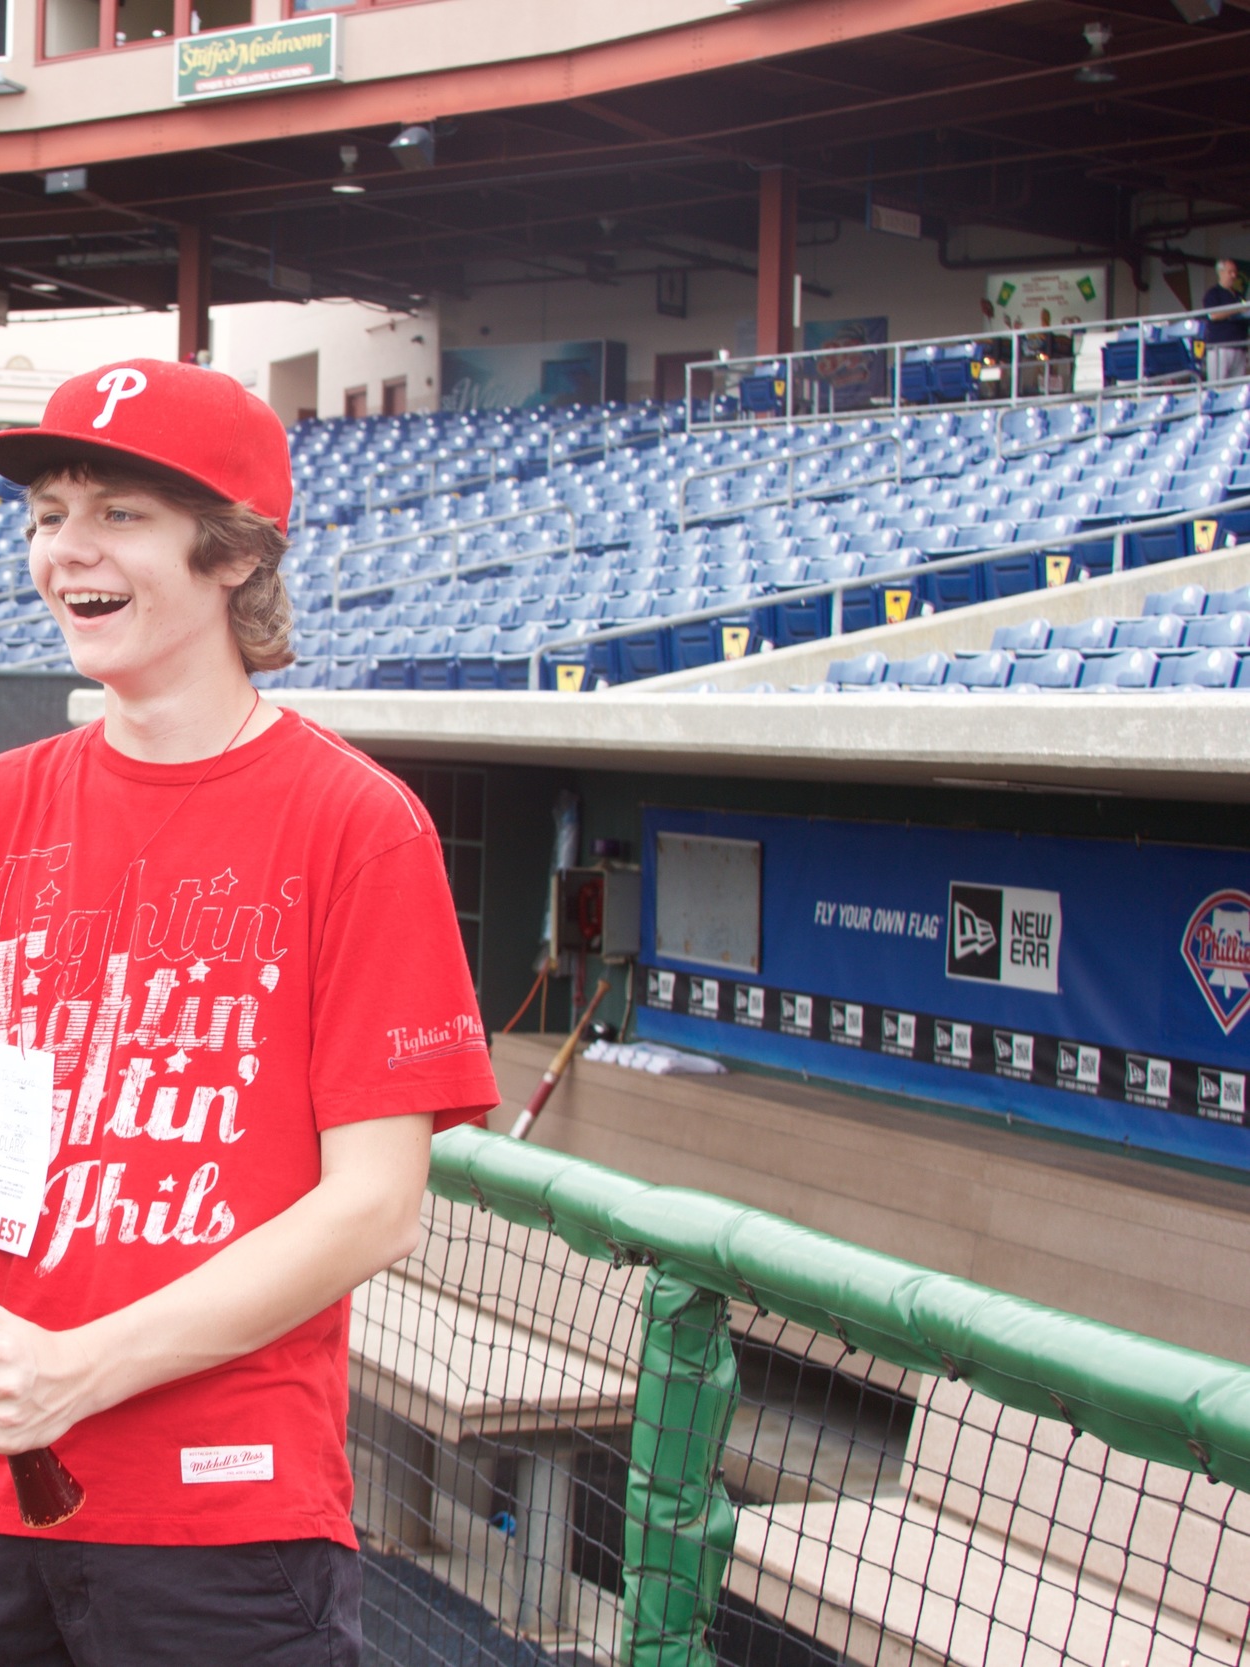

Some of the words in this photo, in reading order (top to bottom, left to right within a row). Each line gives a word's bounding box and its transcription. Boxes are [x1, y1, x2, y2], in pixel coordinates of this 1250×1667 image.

[227, 29, 331, 75] Mushroom
[92, 367, 147, 429] P
[814, 900, 836, 926] FLY
[839, 903, 870, 931] YOUR
[873, 907, 905, 936] OWN
[908, 912, 940, 940] FLAG
[1011, 909, 1052, 940] NEW
[1010, 939, 1050, 969] ERA
[387, 1021, 451, 1058] Fightin'
[36, 1160, 236, 1278] Phils
[190, 1455, 232, 1472] Mitchell
[232, 1454, 239, 1464] &
[240, 1450, 265, 1463] Ness
